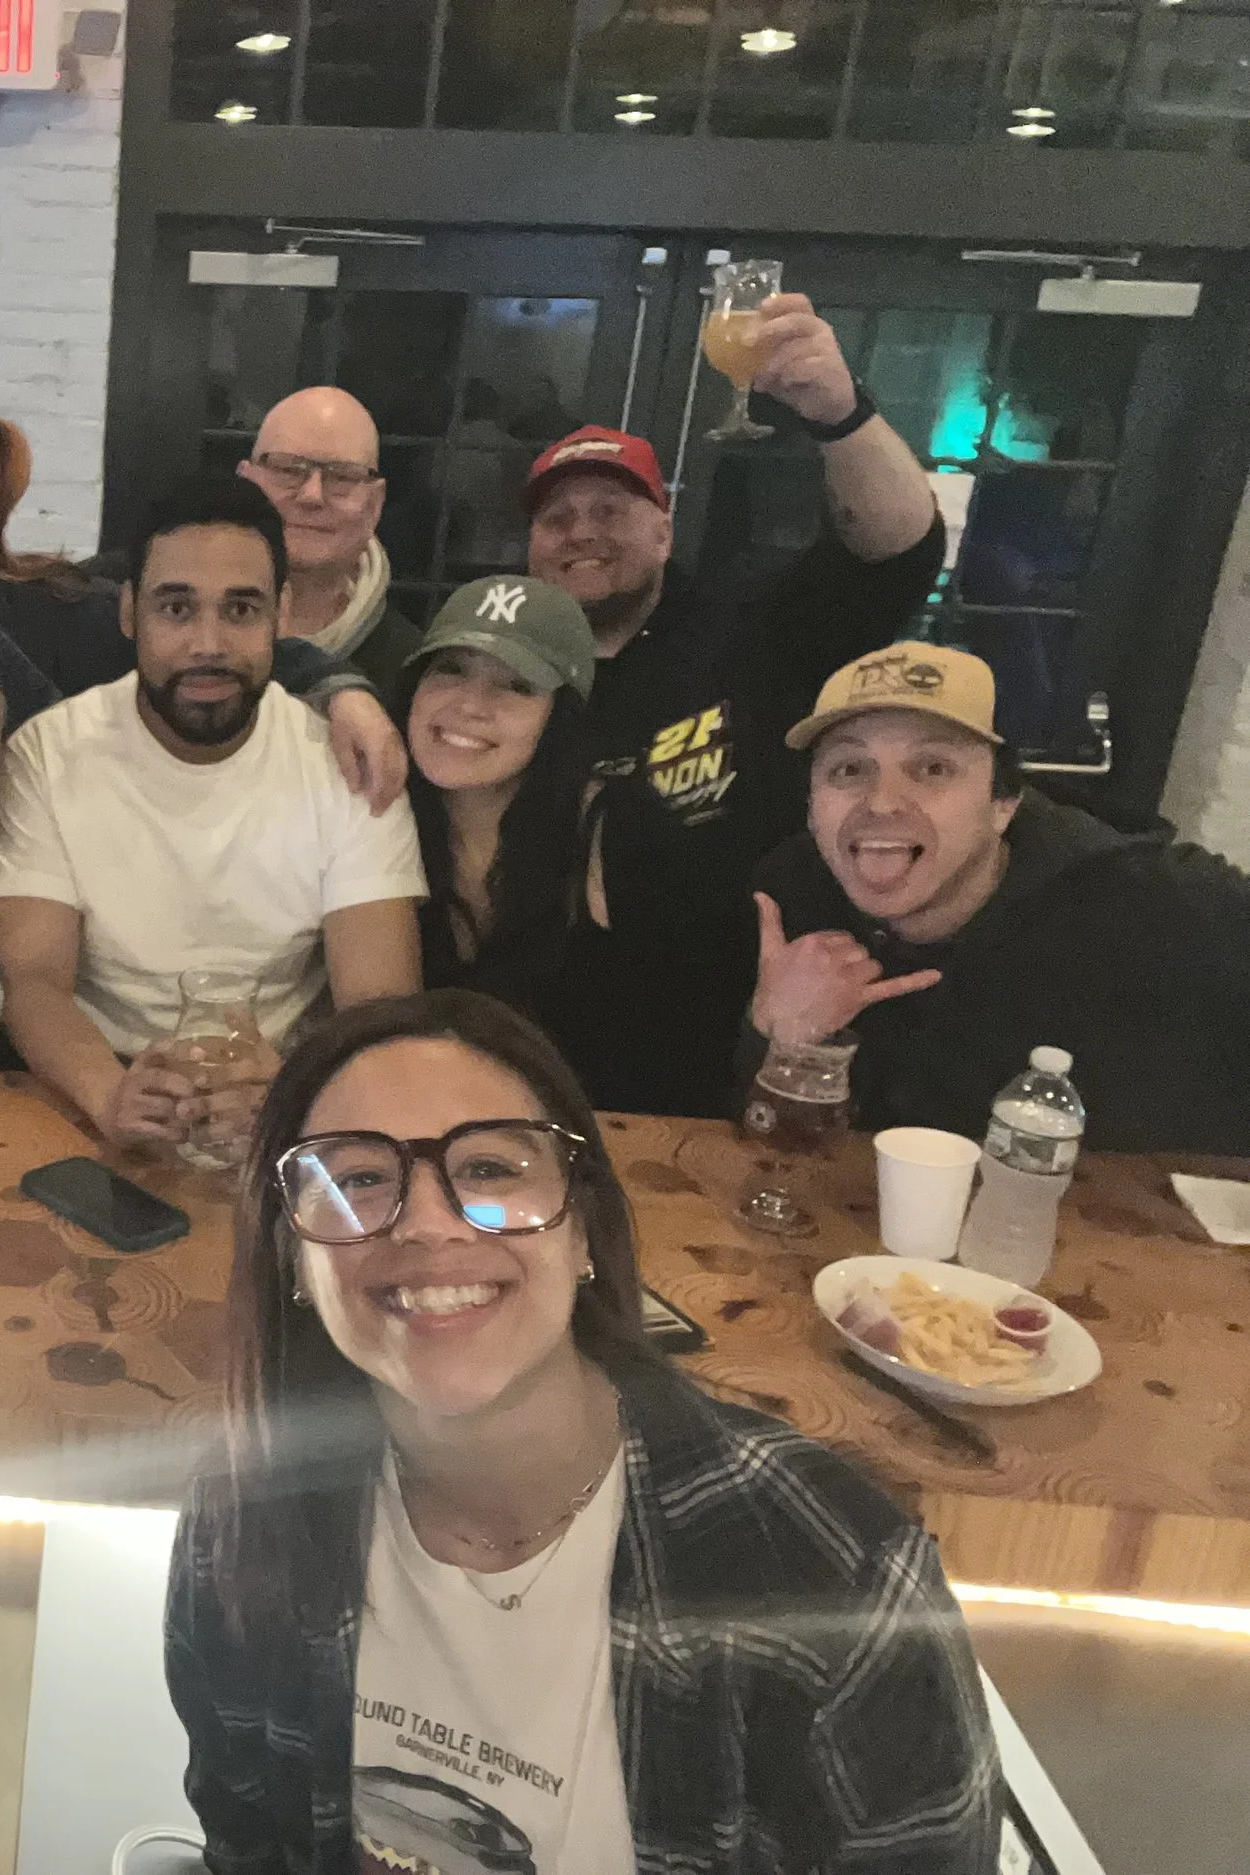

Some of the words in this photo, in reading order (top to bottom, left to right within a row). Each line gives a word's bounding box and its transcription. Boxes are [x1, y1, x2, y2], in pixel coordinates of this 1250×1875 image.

[475, 583, 527, 623] NY
[353, 1693, 405, 1728] OUND
[411, 1712, 474, 1756] TABLE
[478, 1740, 565, 1797] BREWERY
[486, 1771, 505, 1787] NY
